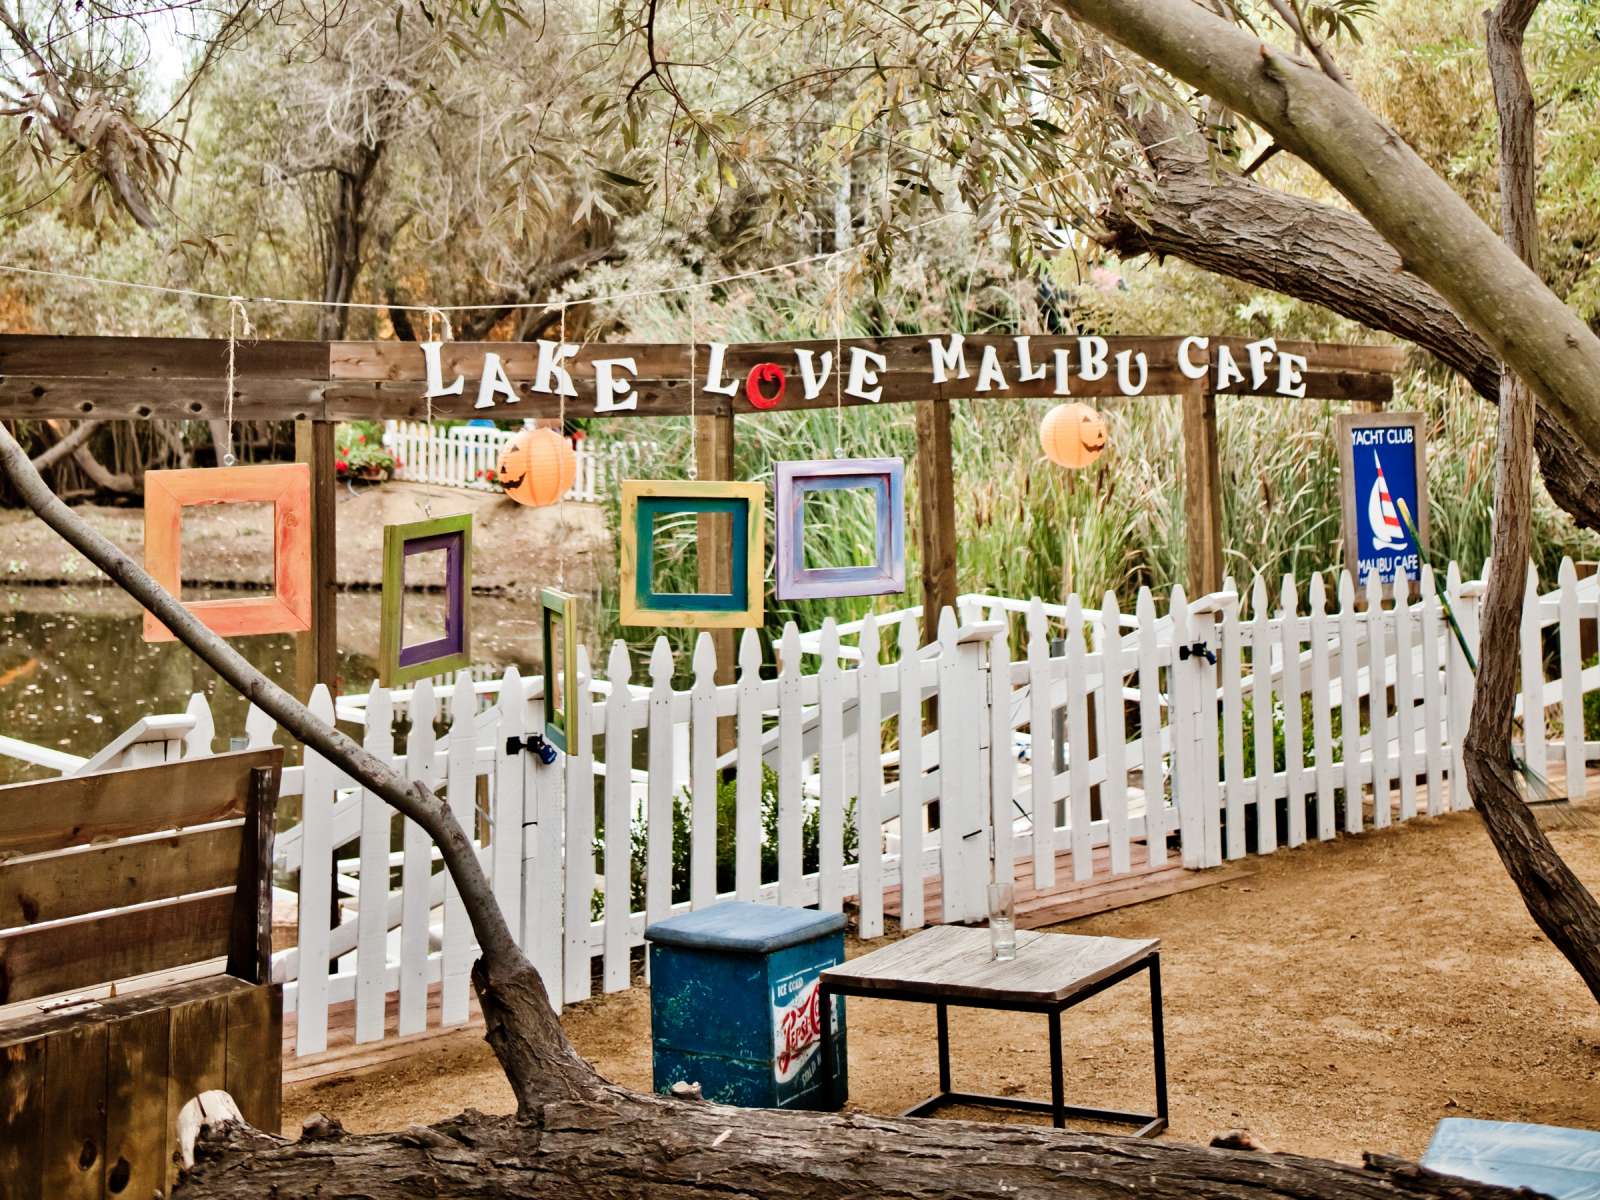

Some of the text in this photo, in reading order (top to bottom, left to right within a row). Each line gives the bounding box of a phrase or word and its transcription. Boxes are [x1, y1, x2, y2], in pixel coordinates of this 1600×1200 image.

[419, 333, 1308, 413] LAKE LOVE MALIBU CAFE
[1351, 428, 1414, 446] YACHT CLUB
[1357, 554, 1419, 574] MALIBU CAFE
